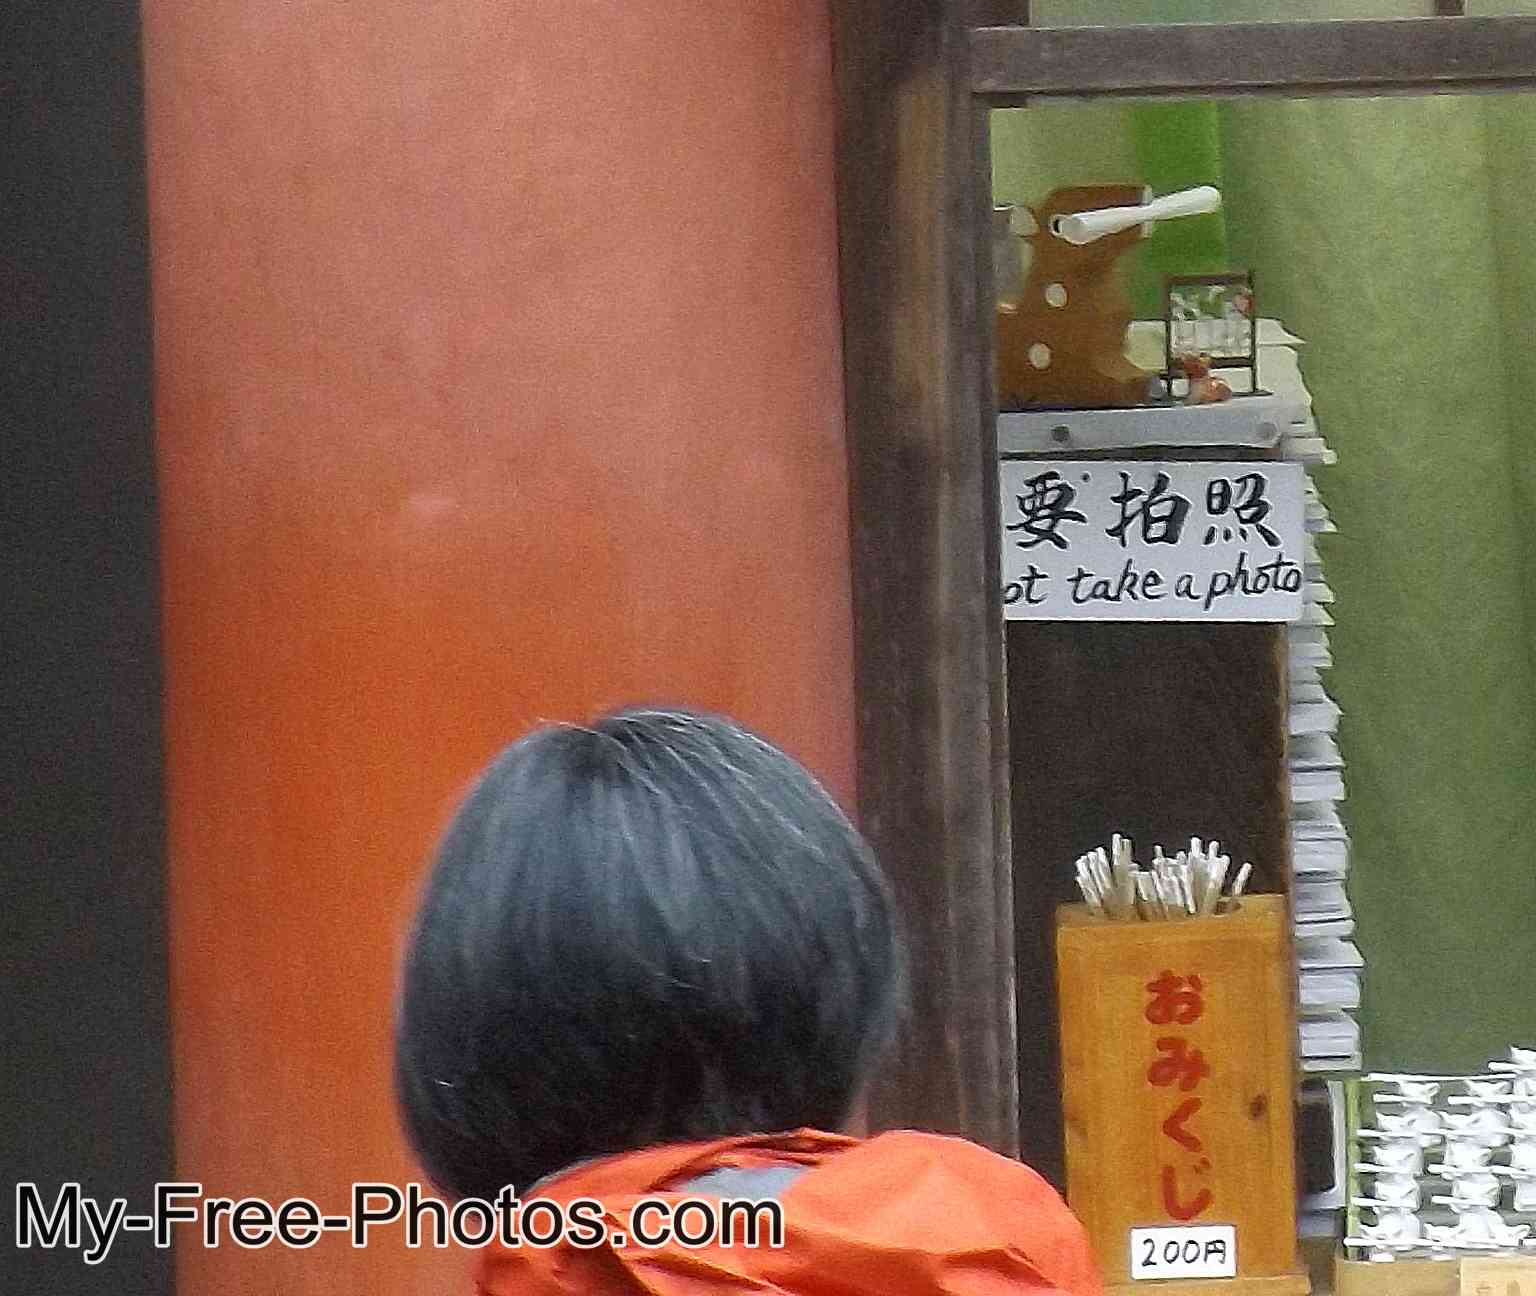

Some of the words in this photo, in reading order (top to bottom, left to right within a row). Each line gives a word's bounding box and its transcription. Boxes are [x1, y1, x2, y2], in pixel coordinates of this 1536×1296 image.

[1005, 471, 1283, 549] 要拍照
[1067, 558, 1166, 602] take
[1175, 572, 1200, 600] a
[1204, 551, 1303, 610] photo
[1145, 970, 1214, 1221] おみくじ
[1142, 1238, 1227, 1267] 200円
